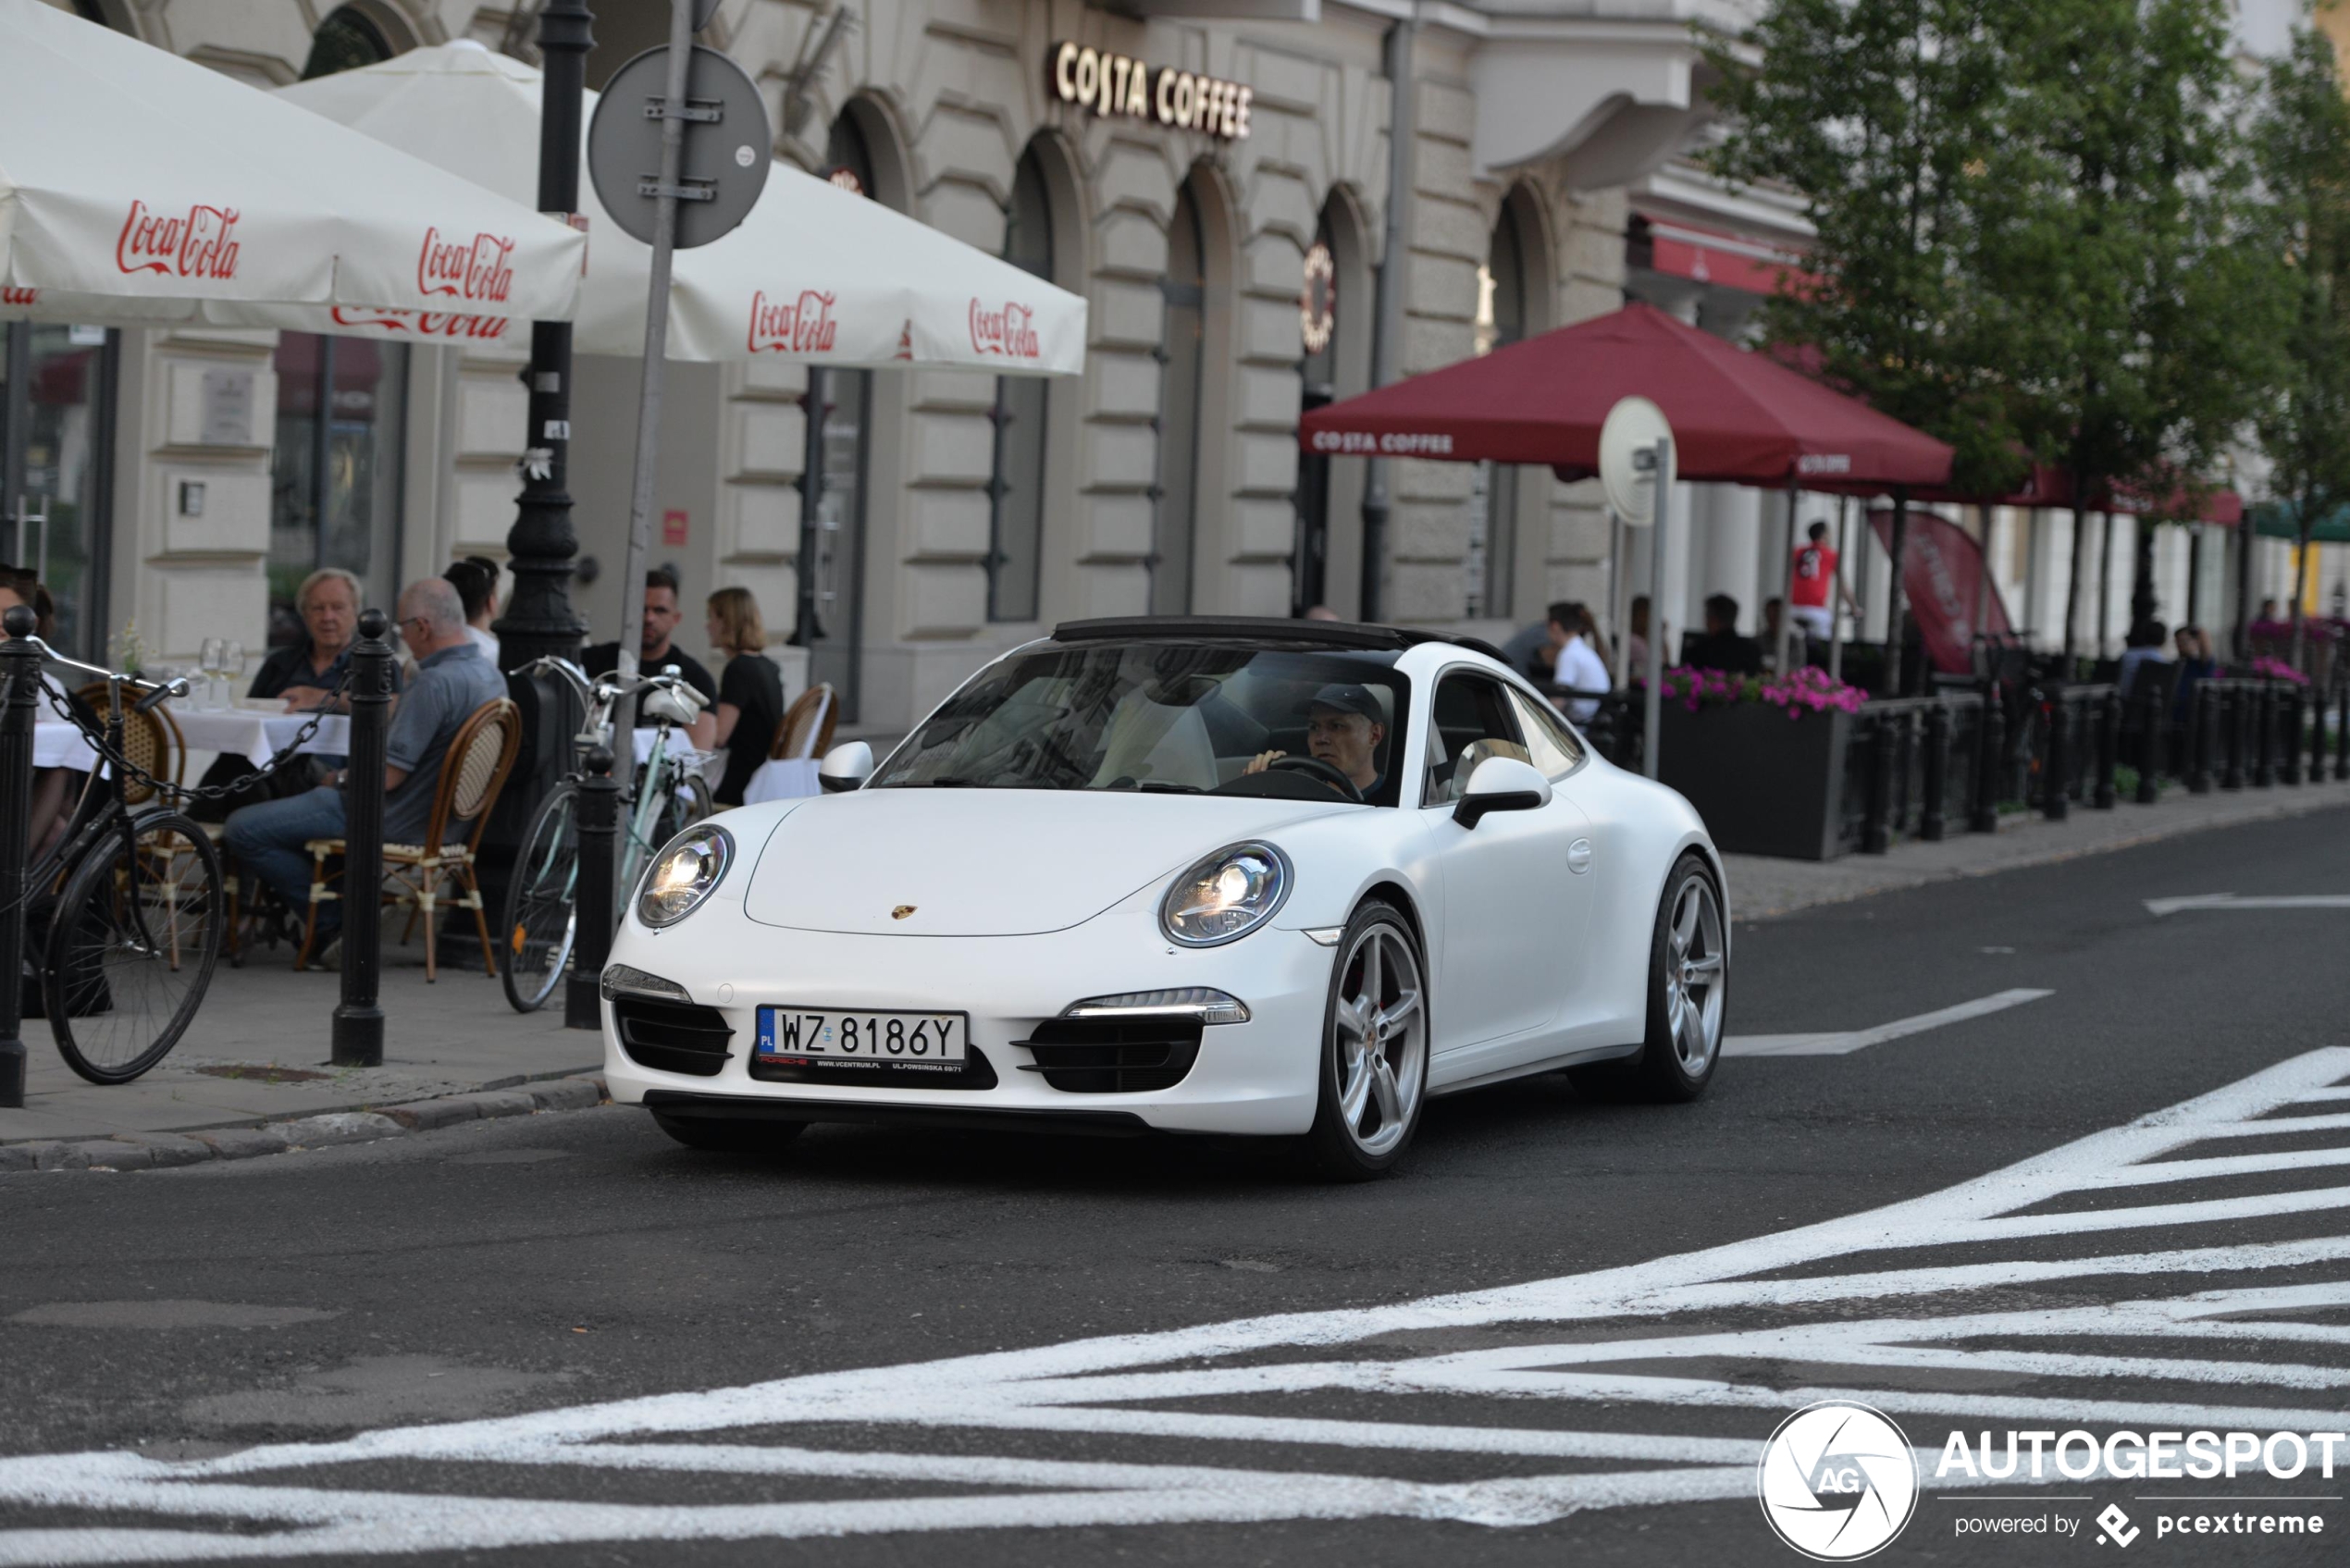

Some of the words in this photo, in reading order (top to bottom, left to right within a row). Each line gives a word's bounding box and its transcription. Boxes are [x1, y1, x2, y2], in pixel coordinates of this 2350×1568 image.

[1057, 42, 1148, 118] COSTA
[1156, 66, 1254, 138] COFFEE
[116, 200, 240, 279] Coca-Cola
[418, 226, 515, 302] Coca-Cola
[748, 290, 836, 352] Coca-Cola
[1312, 430, 1377, 452] COSTA
[1379, 432, 1453, 454] COFFEE
[761, 1035, 773, 1046] PL
[782, 1015, 824, 1051] WZ
[840, 1018, 953, 1056] 8186Y
[817, 1059, 881, 1068] WWW.VCENTRUM.PL
[944, 1065, 962, 1073] 69/71
